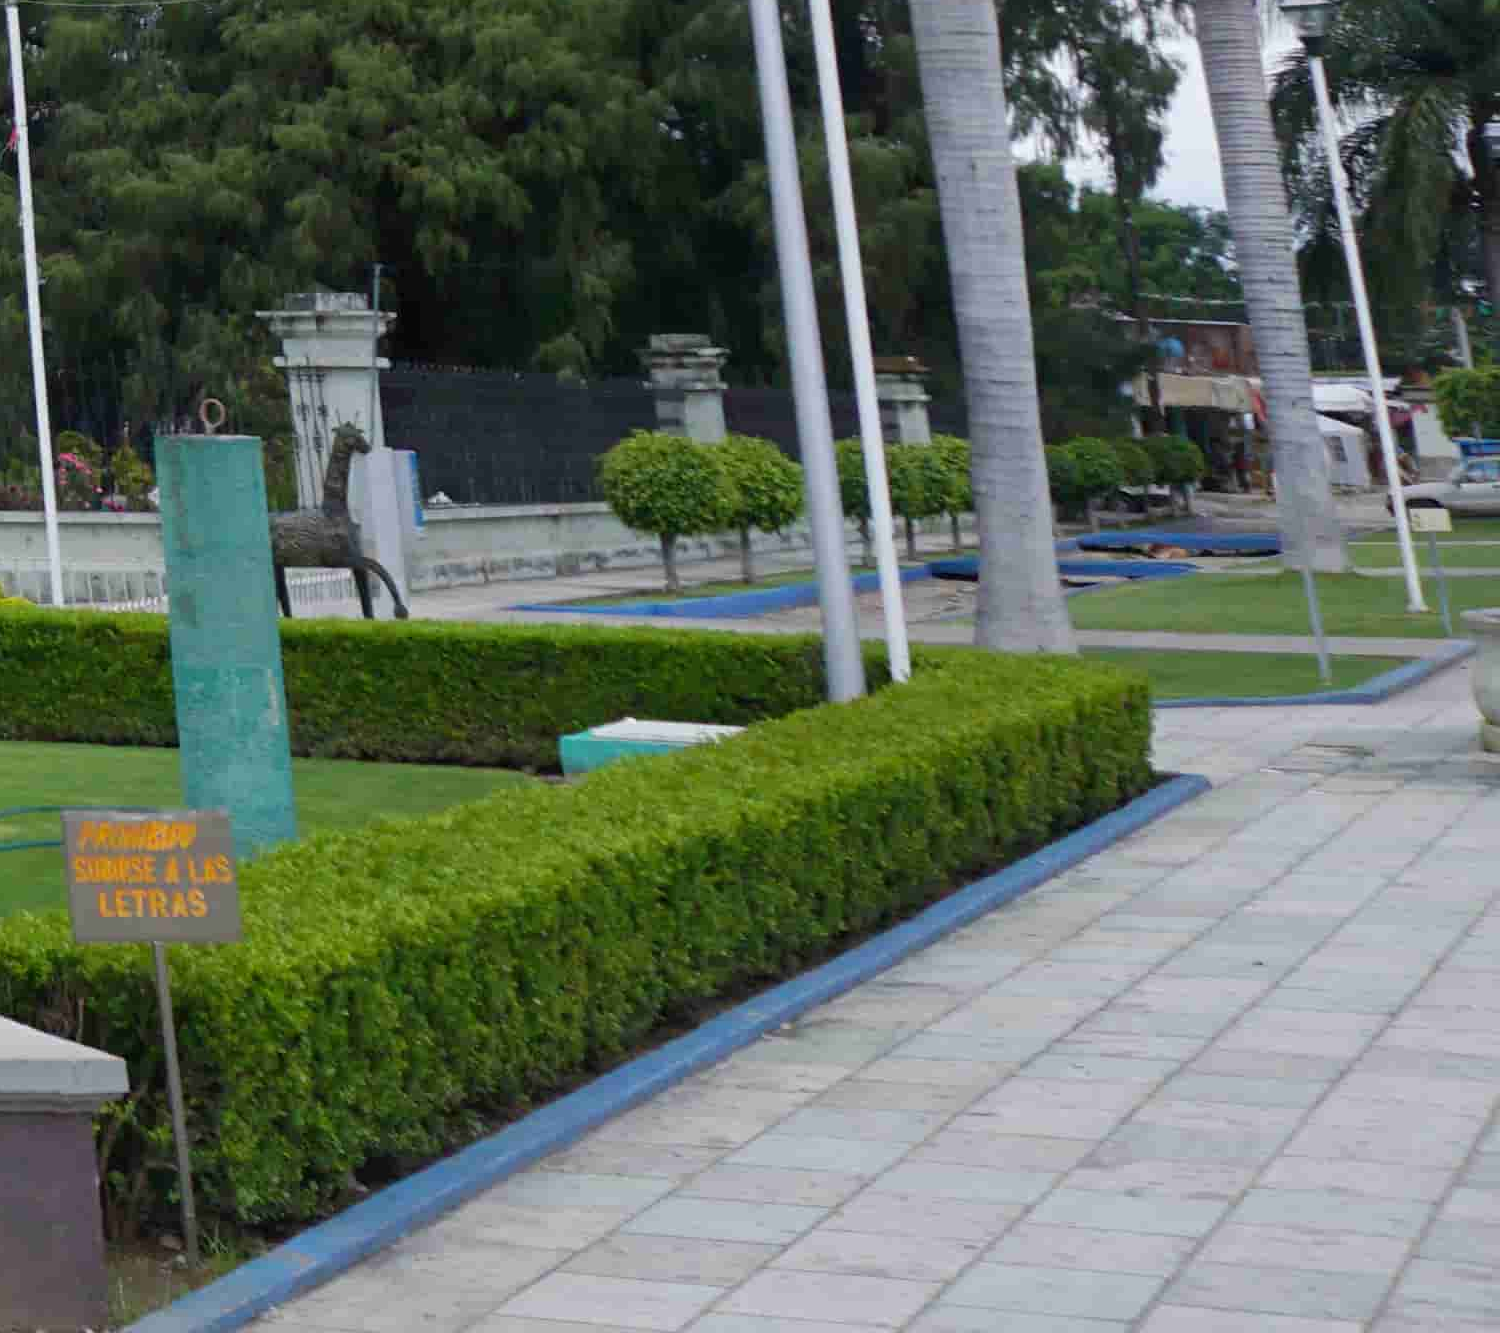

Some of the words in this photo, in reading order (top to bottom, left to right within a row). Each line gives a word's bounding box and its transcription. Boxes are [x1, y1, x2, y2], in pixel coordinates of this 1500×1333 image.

[72, 852, 157, 884] SUBIRSE
[164, 852, 180, 885] A
[186, 851, 234, 885] LAS
[97, 886, 210, 919] LETRAS
